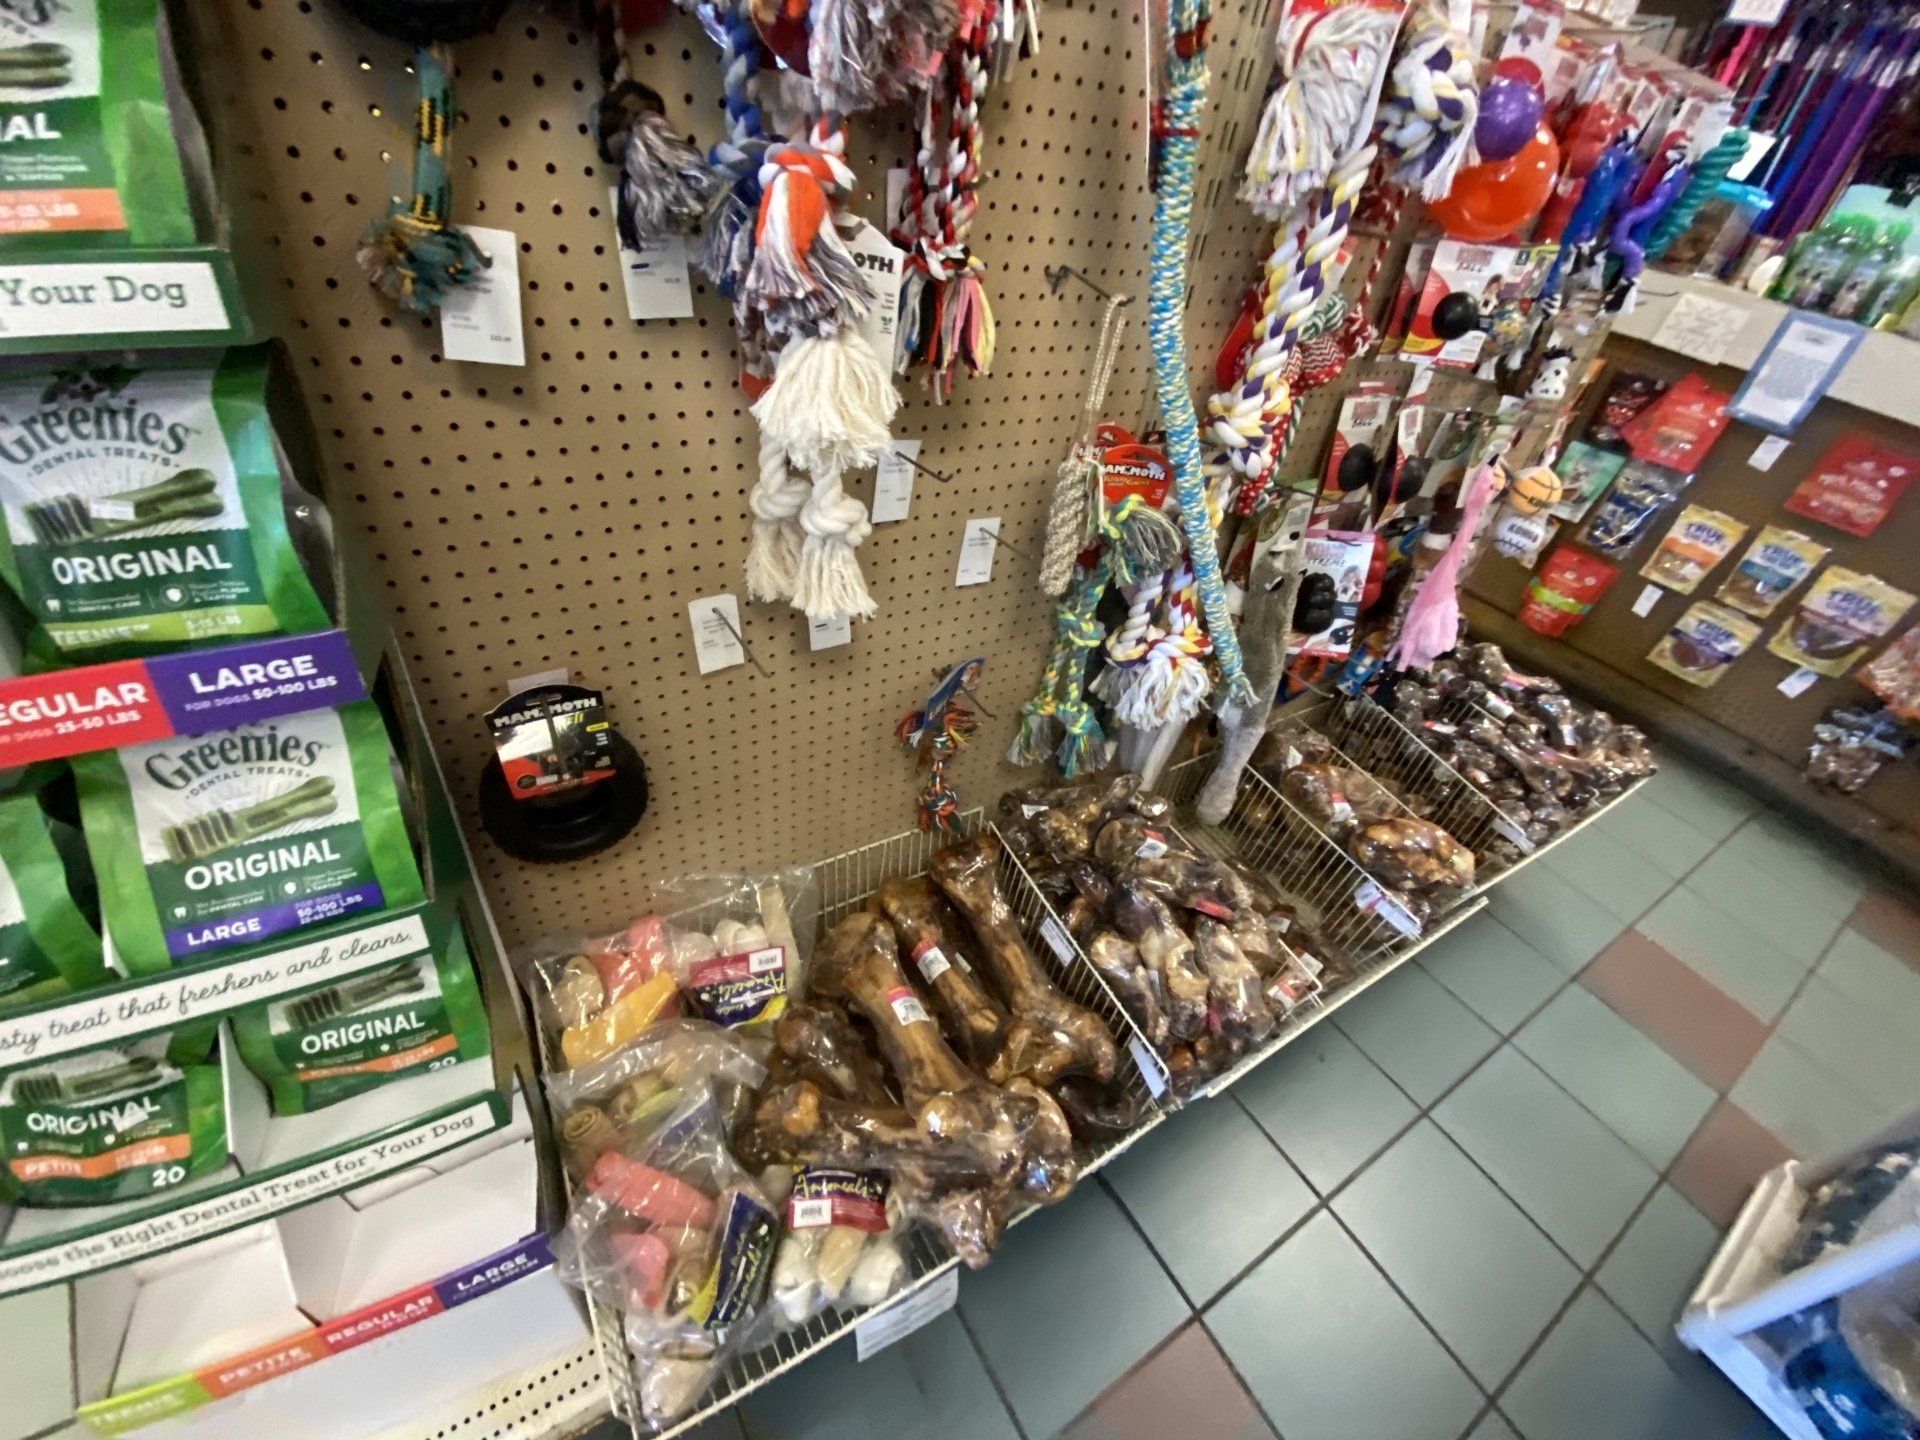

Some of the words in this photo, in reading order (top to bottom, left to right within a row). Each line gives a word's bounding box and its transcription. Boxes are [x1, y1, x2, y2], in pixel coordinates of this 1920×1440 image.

[0, 112, 63, 141] AL
[853, 251, 895, 274] OTH
[0, 278, 95, 306] Your
[103, 275, 188, 308] Dog
[0, 398, 188, 465] Greenies
[31, 448, 96, 476] DENTAL
[102, 447, 172, 467] TREATS
[51, 545, 233, 585] ORIGINAL
[187, 654, 318, 694] LARGE
[252, 682, 306, 701] 50-100
[308, 675, 338, 690] LBS
[56, 716, 105, 735] 25-50
[108, 710, 141, 726] LBS
[145, 725, 322, 790] Greenies
[190, 770, 241, 796] DENTAL
[249, 766, 304, 778] TREATS
[184, 839, 341, 891] ORIGINAL
[186, 918, 262, 946] LARGE
[0, 1029, 42, 1055] sty
[49, 1008, 111, 1038] treat
[118, 992, 171, 1021] that
[178, 970, 279, 1016] freshens
[286, 947, 332, 976] and
[338, 930, 412, 961] cleans.
[300, 1011, 426, 1054] ORIGINAL
[26, 1096, 162, 1136] ORIGINAL
[63, 1242, 107, 1262] the
[109, 1220, 181, 1250] Right
[181, 1191, 262, 1228] Dental
[264, 1169, 332, 1199] Treat
[333, 1157, 368, 1176] for
[371, 1132, 427, 1160] Your
[431, 1114, 475, 1140] Dog
[152, 1166, 186, 1188] 20
[456, 1253, 528, 1291] LARGE
[325, 1294, 434, 1344] REGULAR
